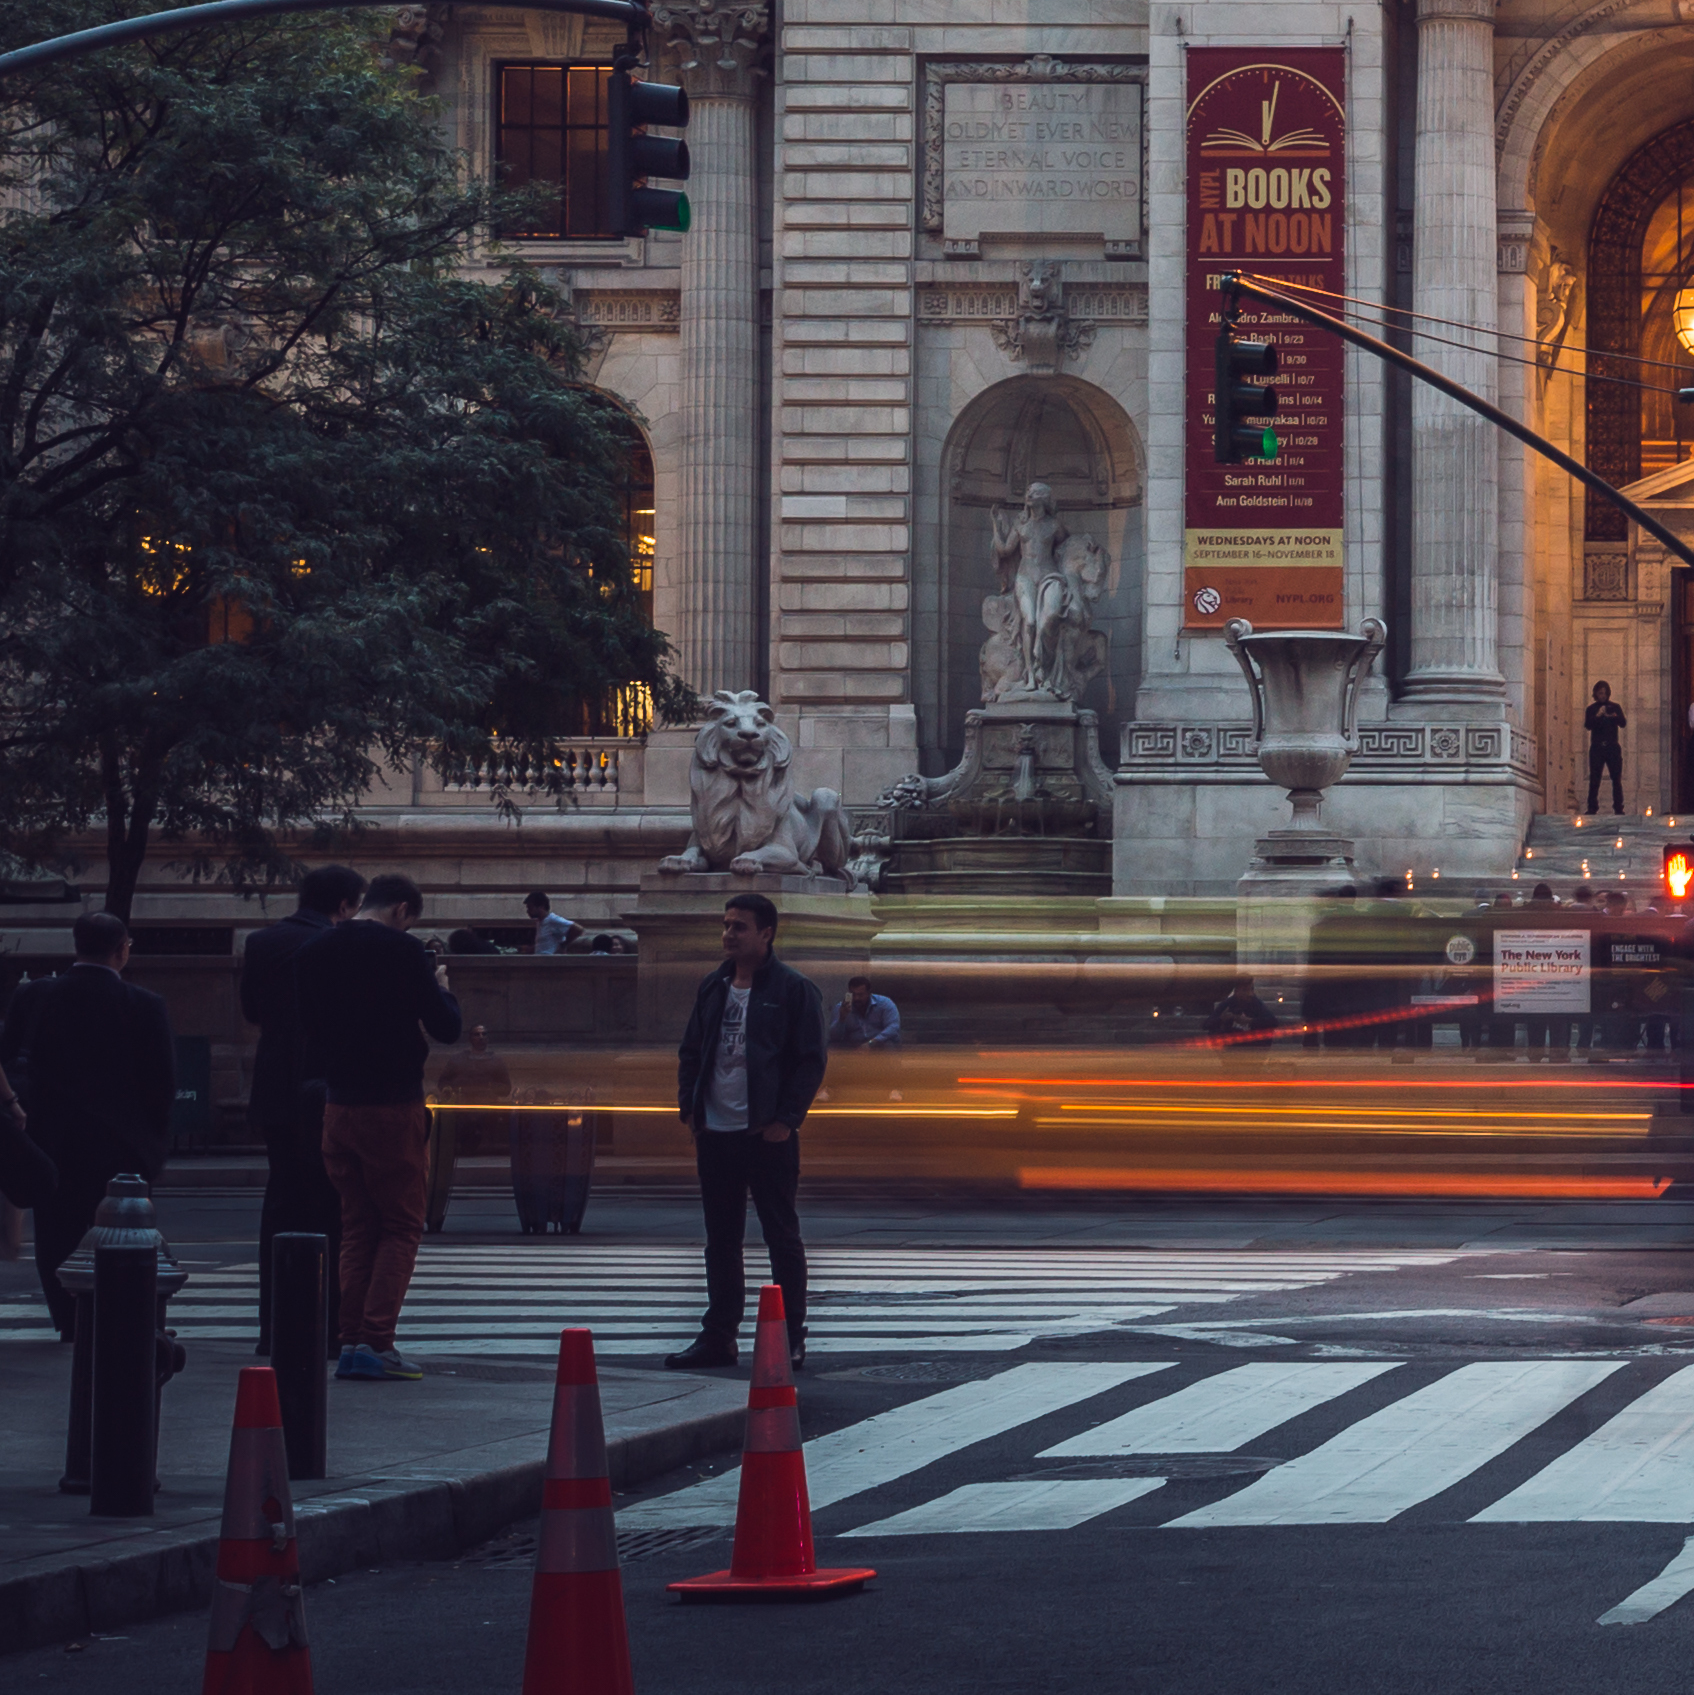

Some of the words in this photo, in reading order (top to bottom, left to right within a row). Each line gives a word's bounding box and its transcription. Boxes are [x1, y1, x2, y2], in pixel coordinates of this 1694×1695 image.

[1003, 93, 1086, 111] BEAUTY
[947, 122, 993, 140] OLD
[993, 122, 1030, 140] YET
[1035, 122, 1083, 140] EVER
[1090, 122, 1139, 140] NEW
[960, 150, 1055, 168] ETERNAL
[1061, 151, 1126, 168] VOICE
[946, 179, 989, 197] AND
[995, 179, 1074, 197] INWARD
[1078, 179, 1138, 197] WORD
[1199, 168, 1221, 209] NYPL
[1226, 168, 1332, 209] BOOKS
[1199, 213, 1238, 253] AT
[1244, 212, 1332, 254] NOON
[1286, 356, 1307, 365] 9/30
[1224, 474, 1255, 486] Sarah
[1257, 474, 1282, 486] Ruhl
[1216, 495, 1237, 506] Ann
[1239, 495, 1288, 506] Goldstein
[1197, 536, 1275, 545] WEDNESDAYS
[1277, 536, 1292, 545] AT
[1294, 536, 1331, 545] NOON
[1193, 549, 1250, 559] SEPTEMBER
[1325, 549, 1335, 559] 18
[1275, 593, 1335, 604] NYPL.ORG
[1501, 949, 1522, 960] The
[1525, 949, 1553, 960] New
[1555, 949, 1581, 960] York
[1501, 962, 1538, 973] Public
[1540, 962, 1583, 976] Library
